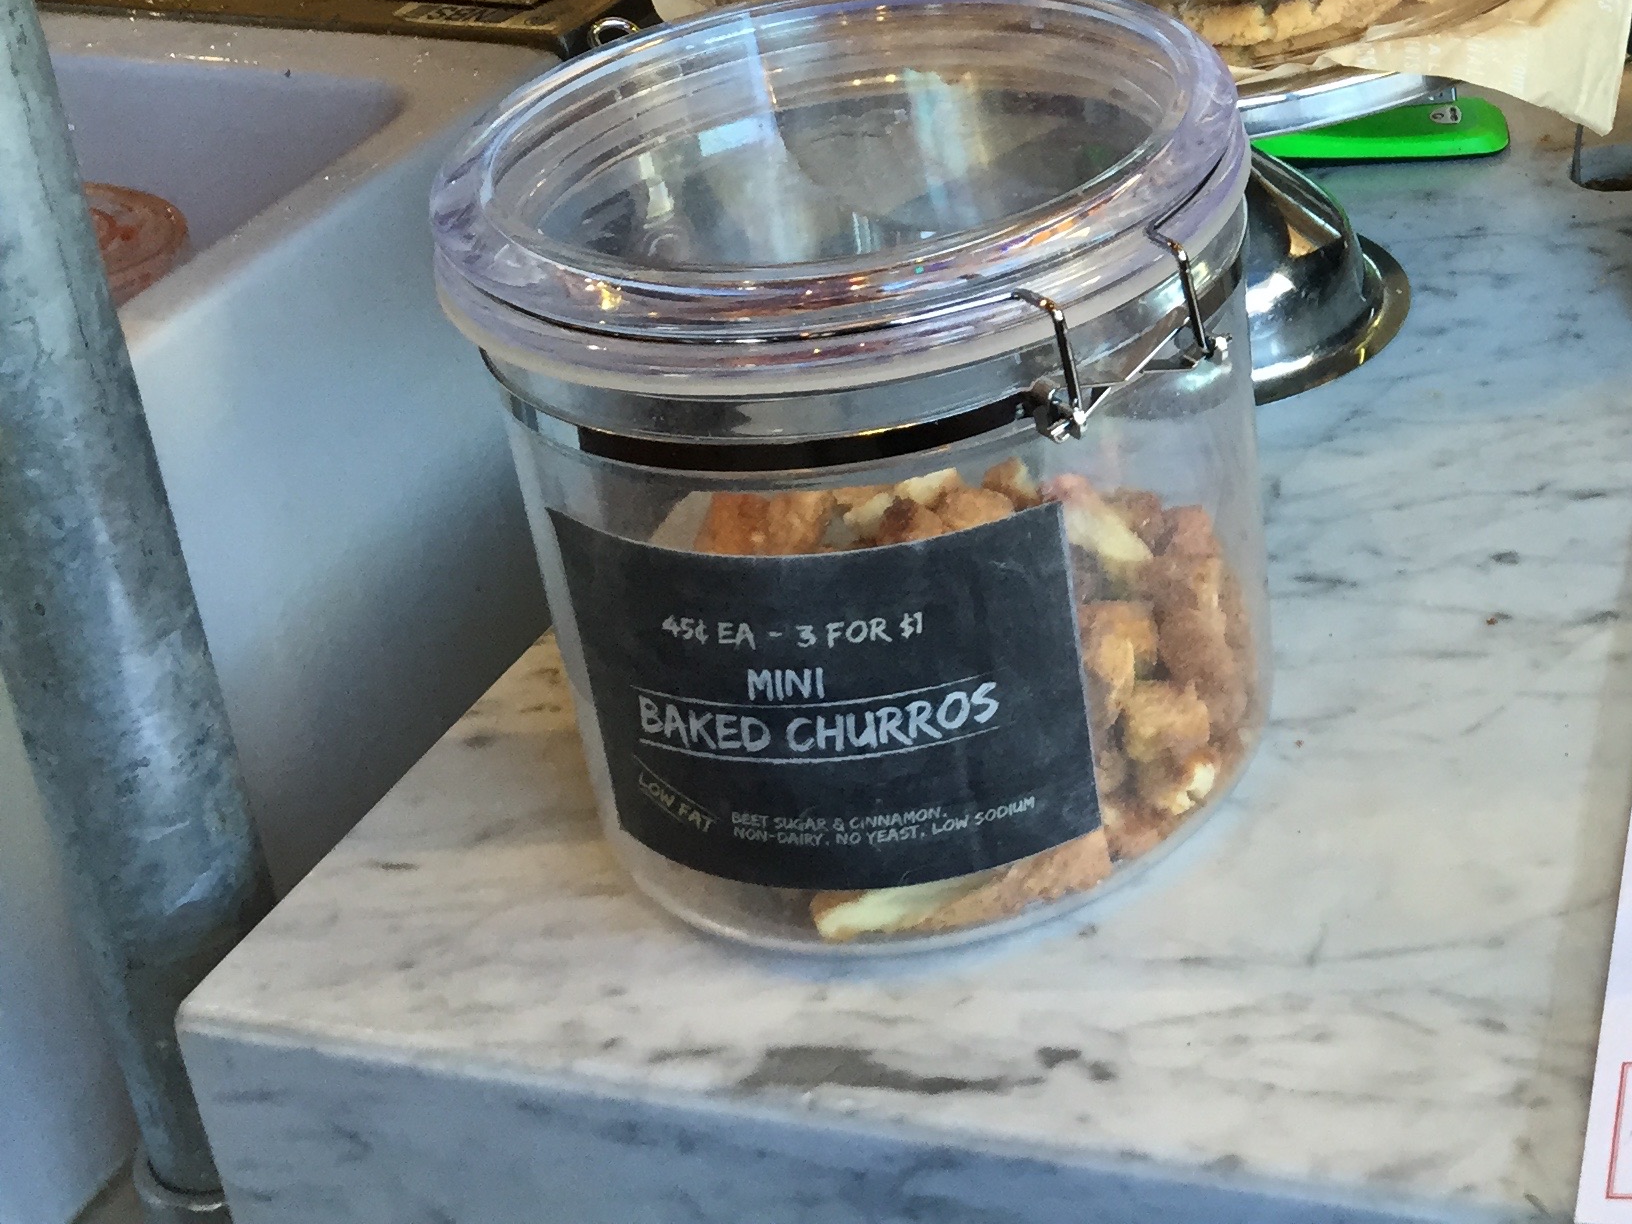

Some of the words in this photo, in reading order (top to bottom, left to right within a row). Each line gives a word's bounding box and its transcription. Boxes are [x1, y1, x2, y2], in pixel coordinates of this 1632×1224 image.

[718, 622, 755, 650] EA
[797, 624, 816, 647] 3
[827, 618, 891, 649] FOR
[900, 611, 923, 639] $1
[747, 667, 826, 701] MINI
[638, 696, 771, 752] BAKED
[786, 681, 1001, 752] CHURROS
[638, 774, 675, 810] LOW
[677, 799, 715, 835] FAT
[731, 811, 768, 825] BEET
[774, 817, 828, 831] SUGAR
[833, 820, 844, 831] &
[836, 832, 860, 845] NO
[932, 815, 968, 836] LOW
[974, 796, 1036, 825] SODIUM
